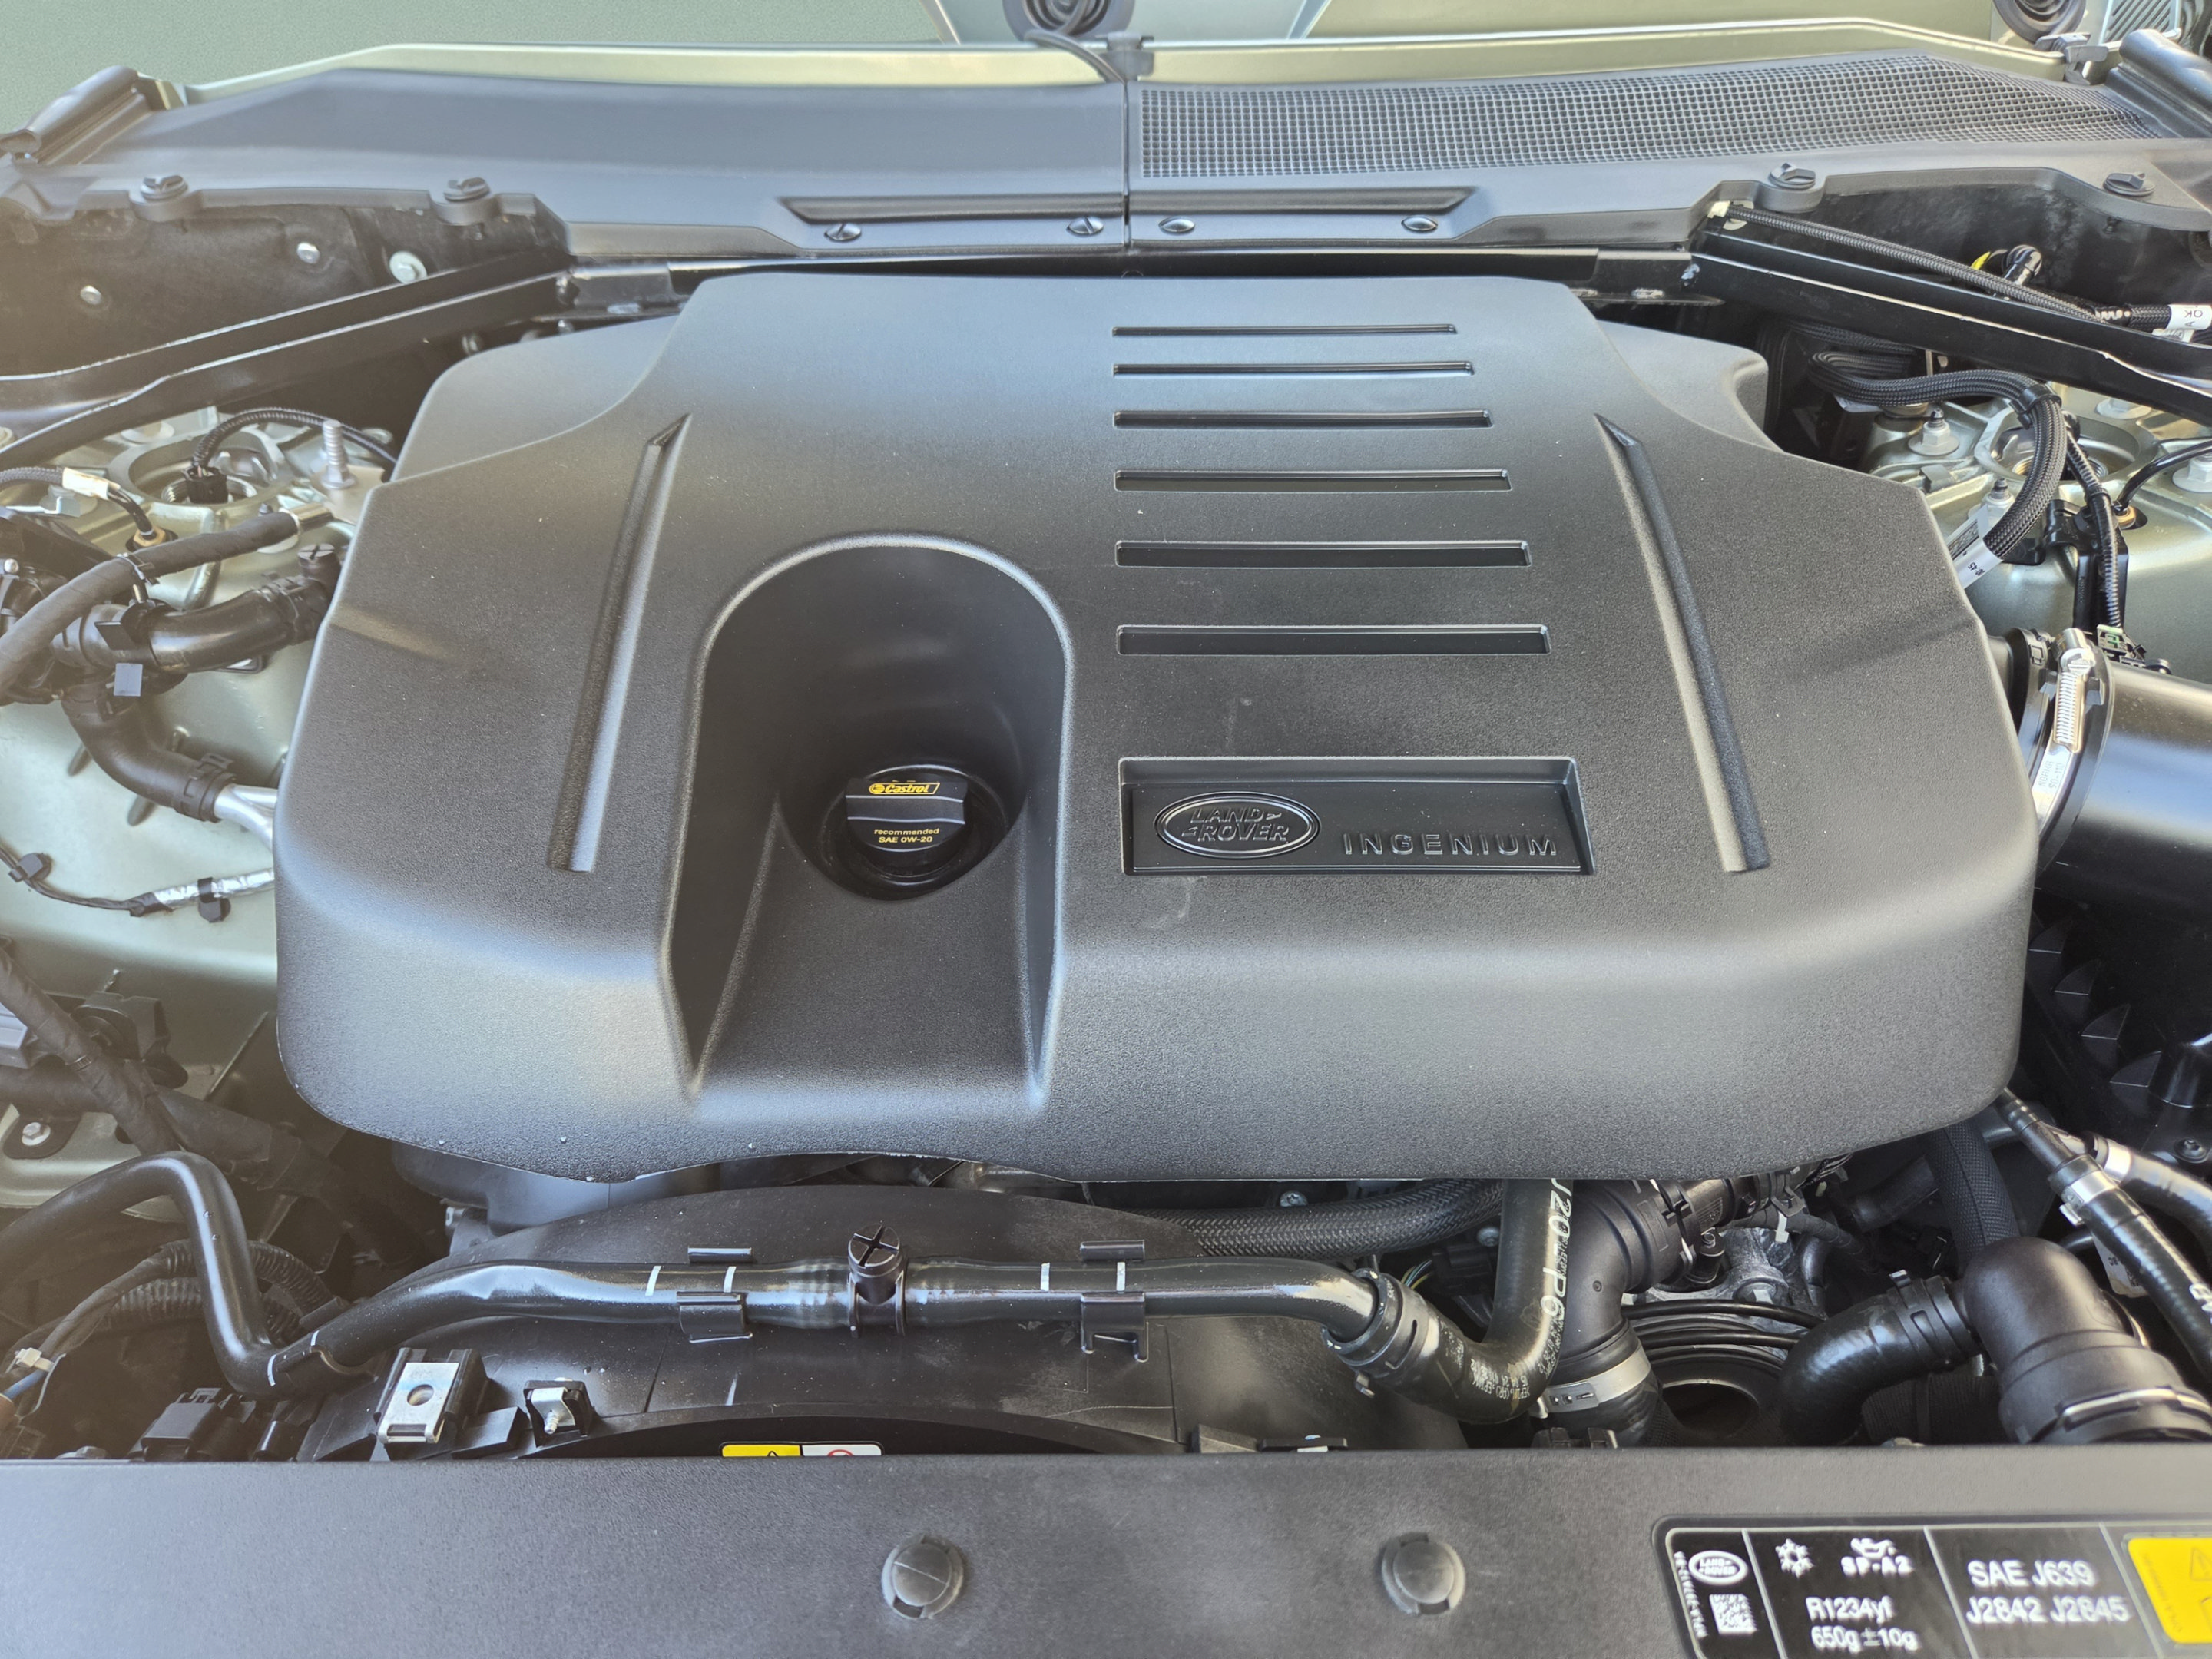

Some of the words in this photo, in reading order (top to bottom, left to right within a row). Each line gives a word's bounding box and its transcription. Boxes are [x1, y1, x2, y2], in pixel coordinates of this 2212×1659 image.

[884, 783, 930, 794] Castrol
[1343, 832, 1558, 856] INGENIUM
[1968, 1560, 2029, 1587] SAE
[2032, 1560, 2098, 1587] J639
[1966, 1596, 2048, 1624] J2842
[2050, 1595, 2132, 1623] J2845
